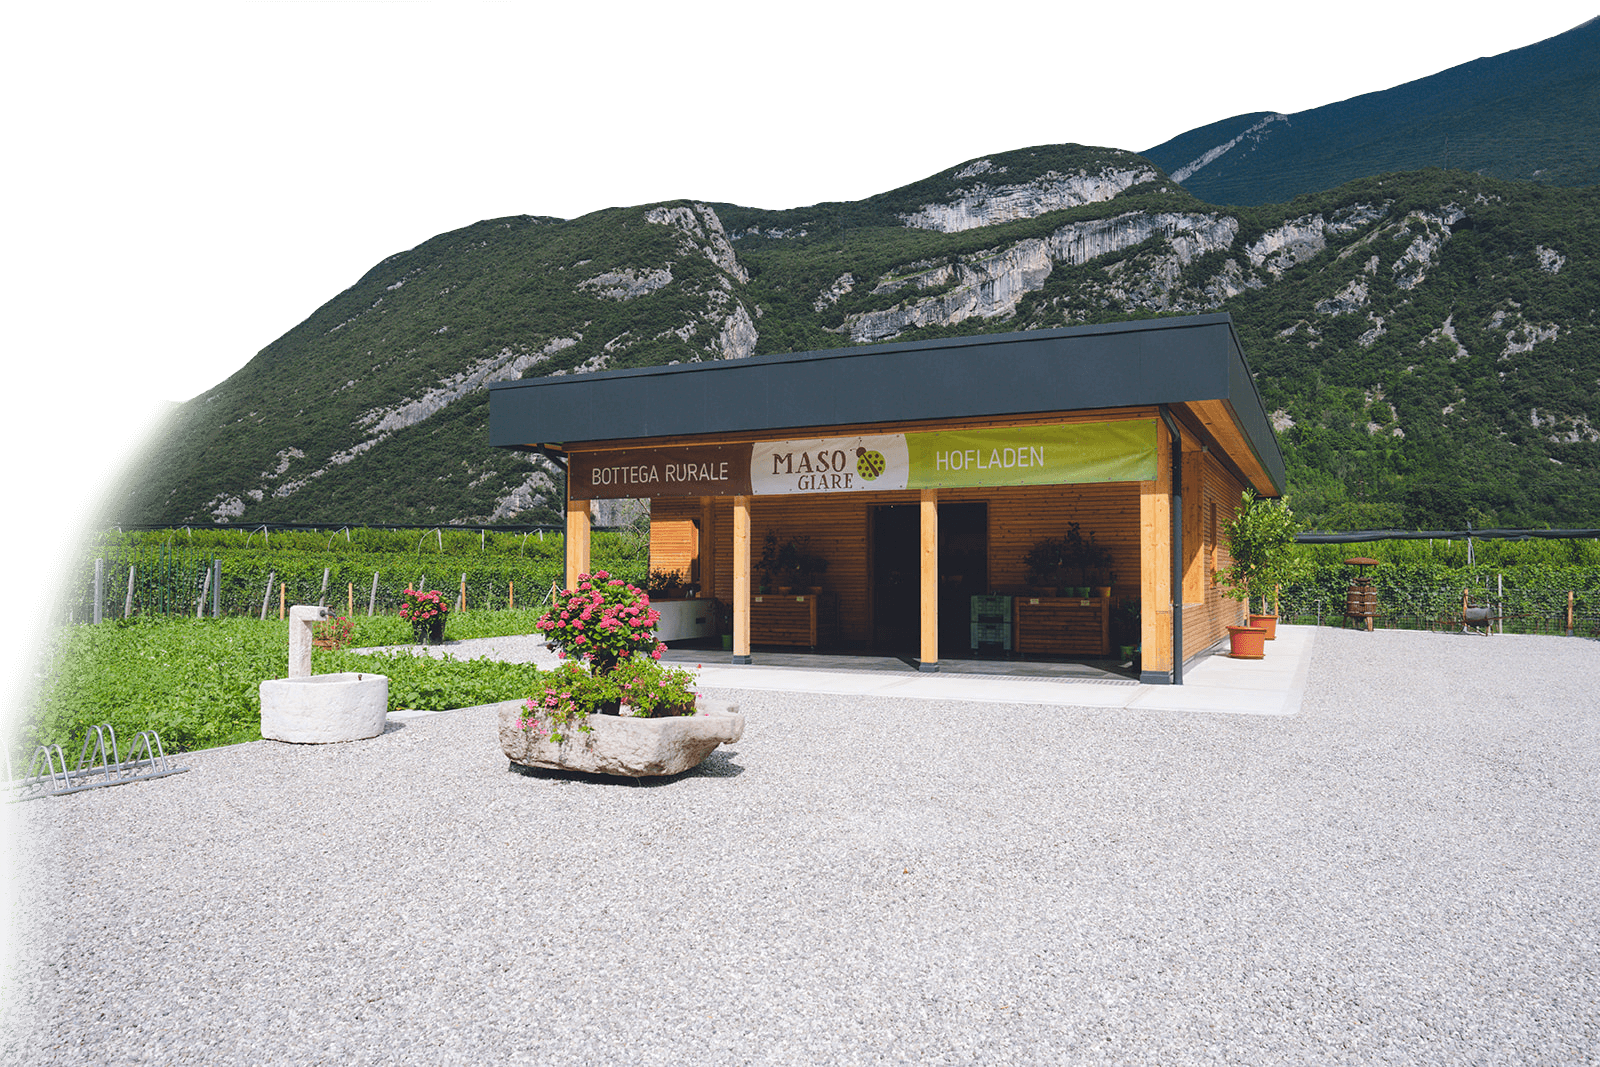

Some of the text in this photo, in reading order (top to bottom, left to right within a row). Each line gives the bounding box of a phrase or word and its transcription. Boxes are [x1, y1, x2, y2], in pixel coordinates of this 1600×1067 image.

[772, 450, 846, 475] MASO
[936, 446, 1044, 471] HOFLADEN
[592, 462, 728, 485] BOTTEGA RURALE
[798, 473, 853, 490] GIARE
